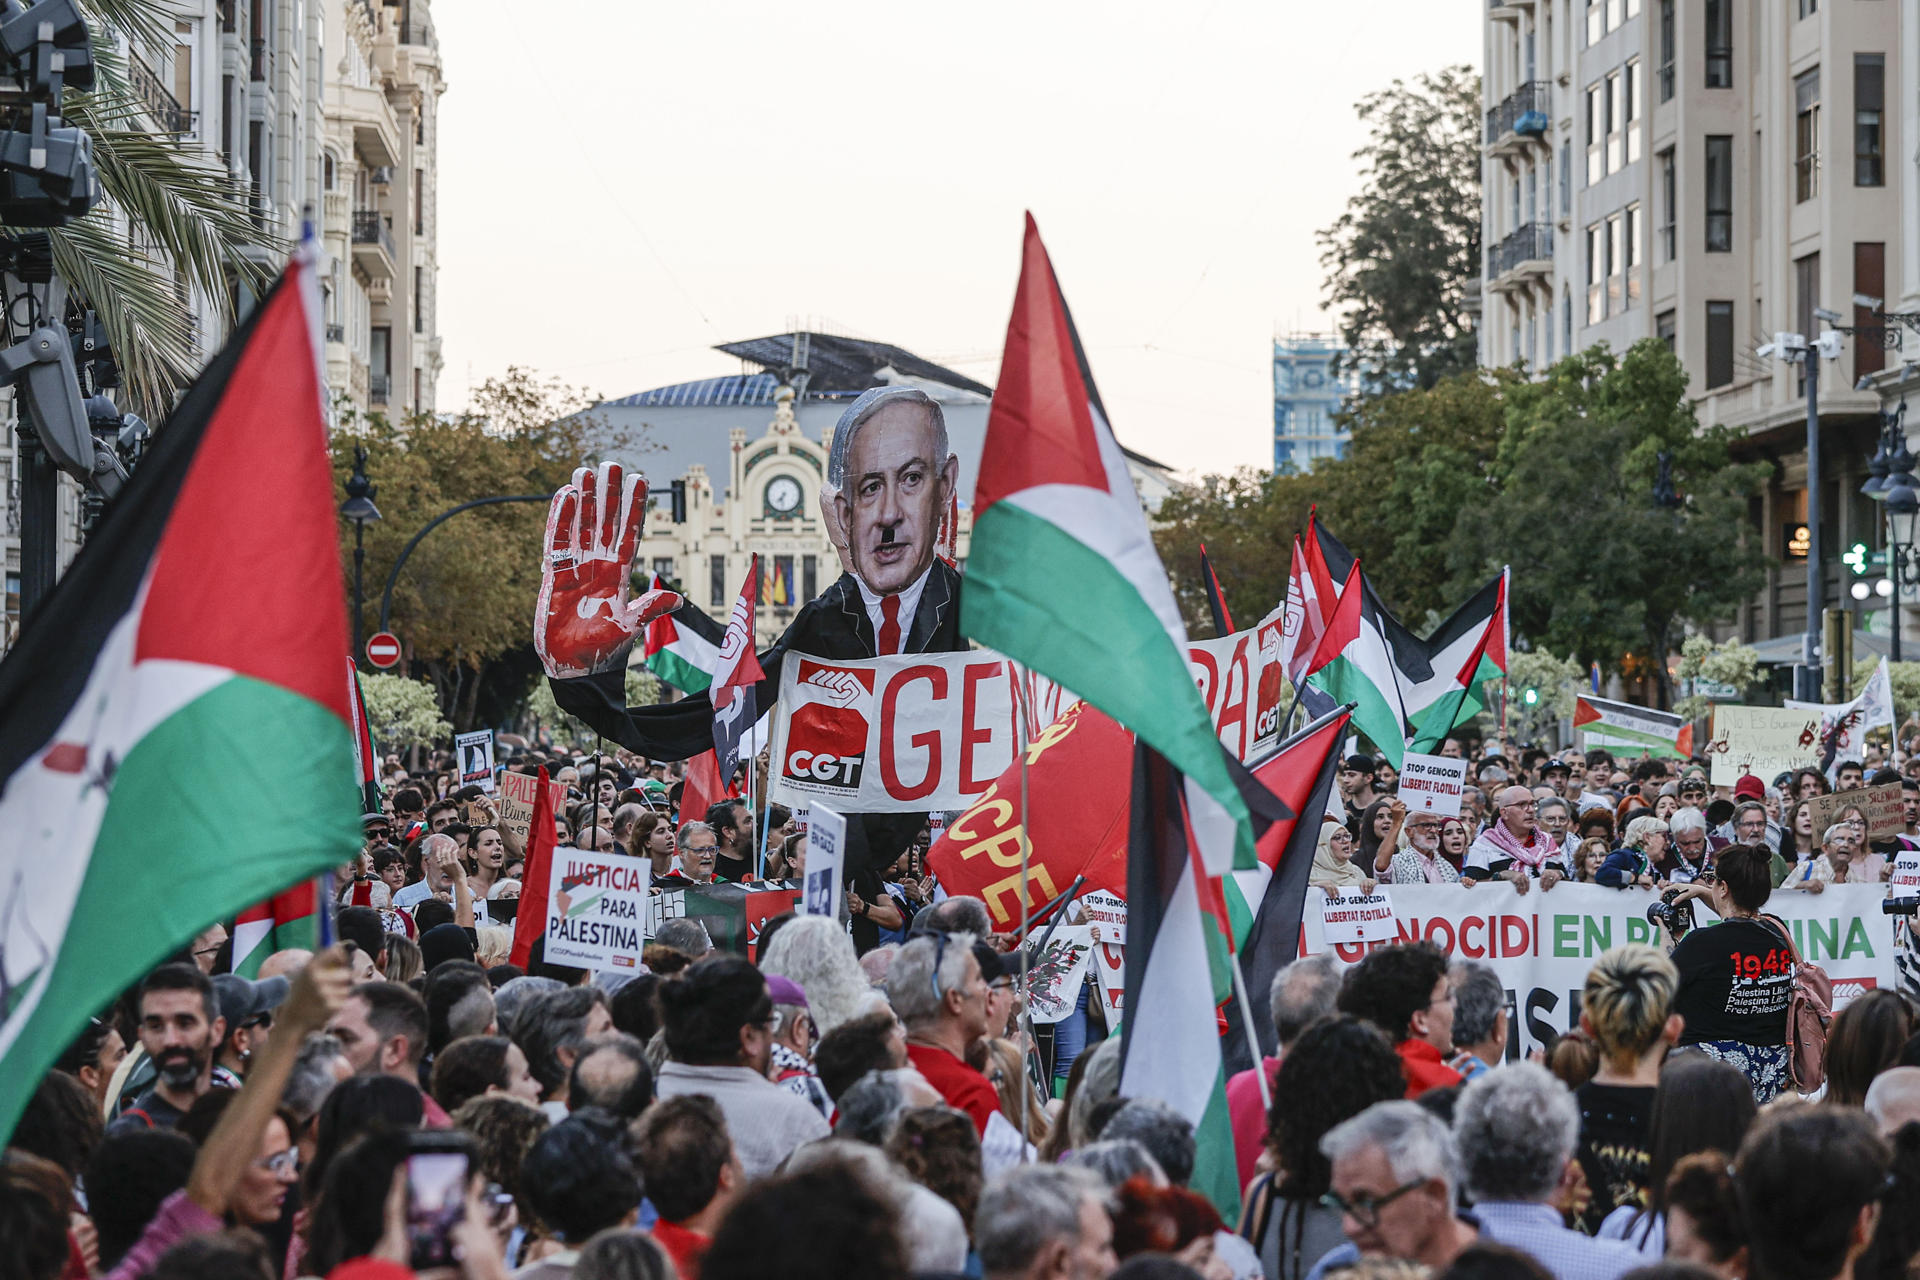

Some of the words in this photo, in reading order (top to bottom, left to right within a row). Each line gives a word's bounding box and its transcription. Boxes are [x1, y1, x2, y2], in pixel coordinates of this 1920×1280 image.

[788, 750, 862, 784] CGT
[1406, 763, 1425, 774] STOP
[1427, 766, 1461, 779] GENOCIDI
[1401, 776, 1432, 792] LLIBERTAT
[1433, 781, 1460, 797] FLOTILLA
[1820, 798, 1831, 810] SE
[949, 782, 1060, 925] CPE
[1898, 861, 1919, 870] STOP
[562, 861, 640, 893] JUSTICIA
[601, 897, 637, 920] PARA
[1086, 895, 1103, 906] STOP
[1325, 896, 1346, 906] STOP
[1348, 895, 1386, 905] GENOCIDI
[1324, 910, 1358, 923] LLIBERTAT
[1359, 906, 1393, 921] FLOTILLA
[549, 917, 639, 952] PALESTINA
[1553, 914, 1611, 958] EN
[1730, 948, 1790, 980] 1948
[1729, 987, 1770, 997] Palestina
[1724, 1005, 1748, 1014] Free
[1727, 996, 1769, 1006] Palestina
